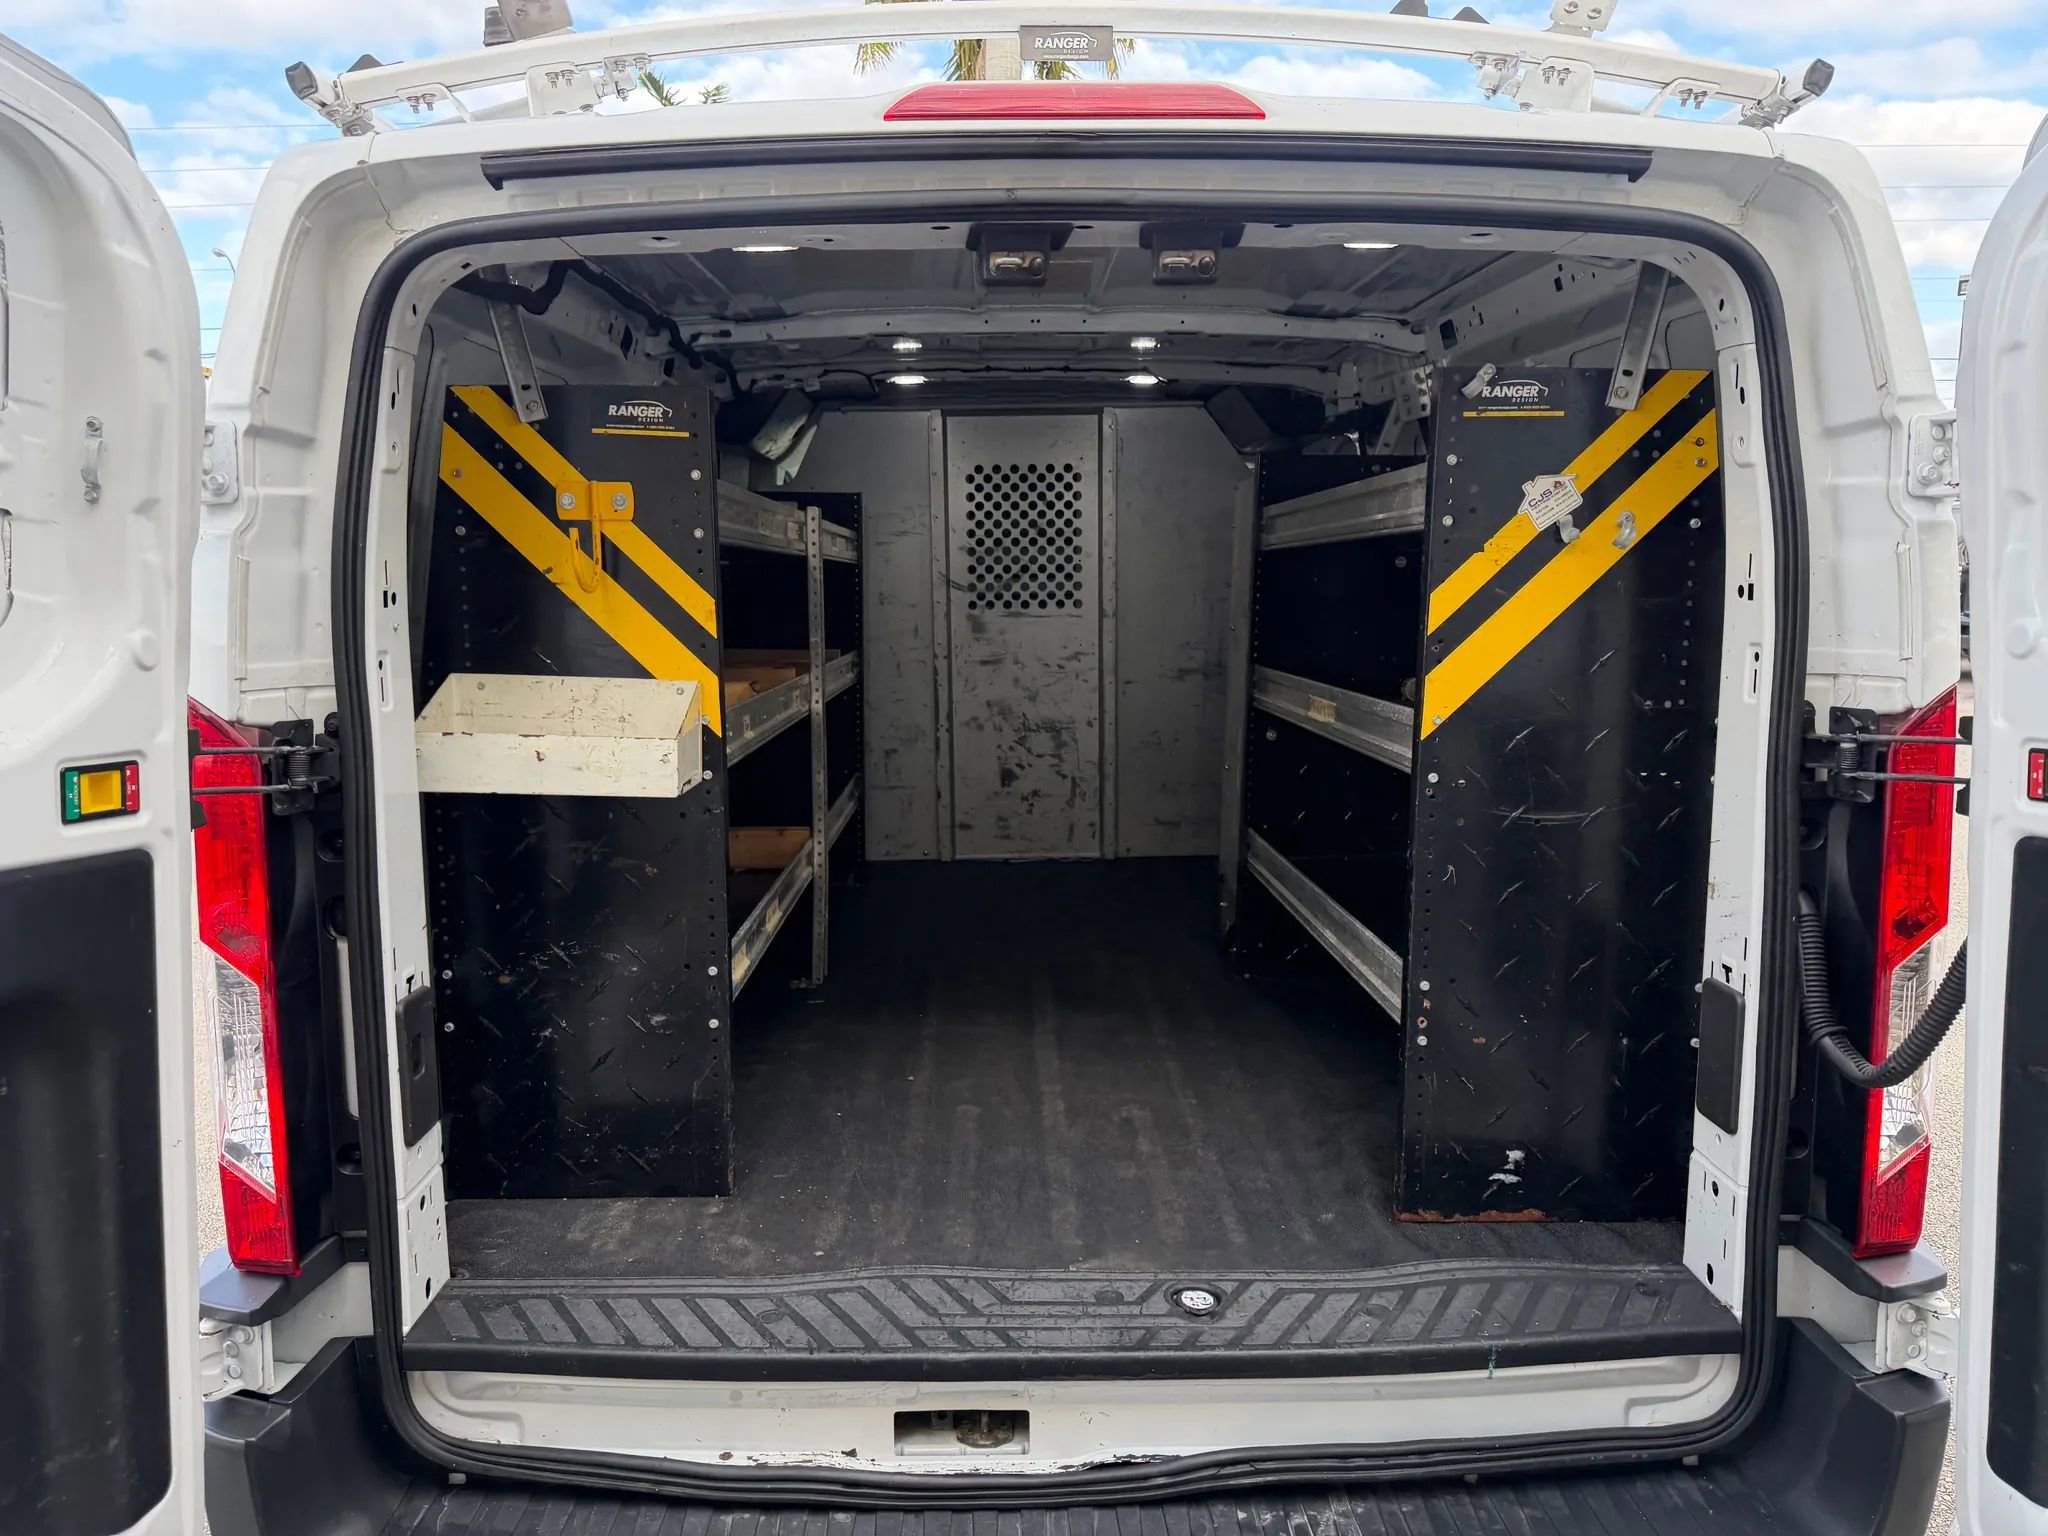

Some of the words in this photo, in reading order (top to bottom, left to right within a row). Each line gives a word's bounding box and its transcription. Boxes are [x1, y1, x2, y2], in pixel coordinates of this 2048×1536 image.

[1034, 37, 1089, 48] RANGER
[1482, 385, 1539, 397] RANGER
[608, 405, 664, 417] RANGER
[1528, 488, 1553, 508] CJS
